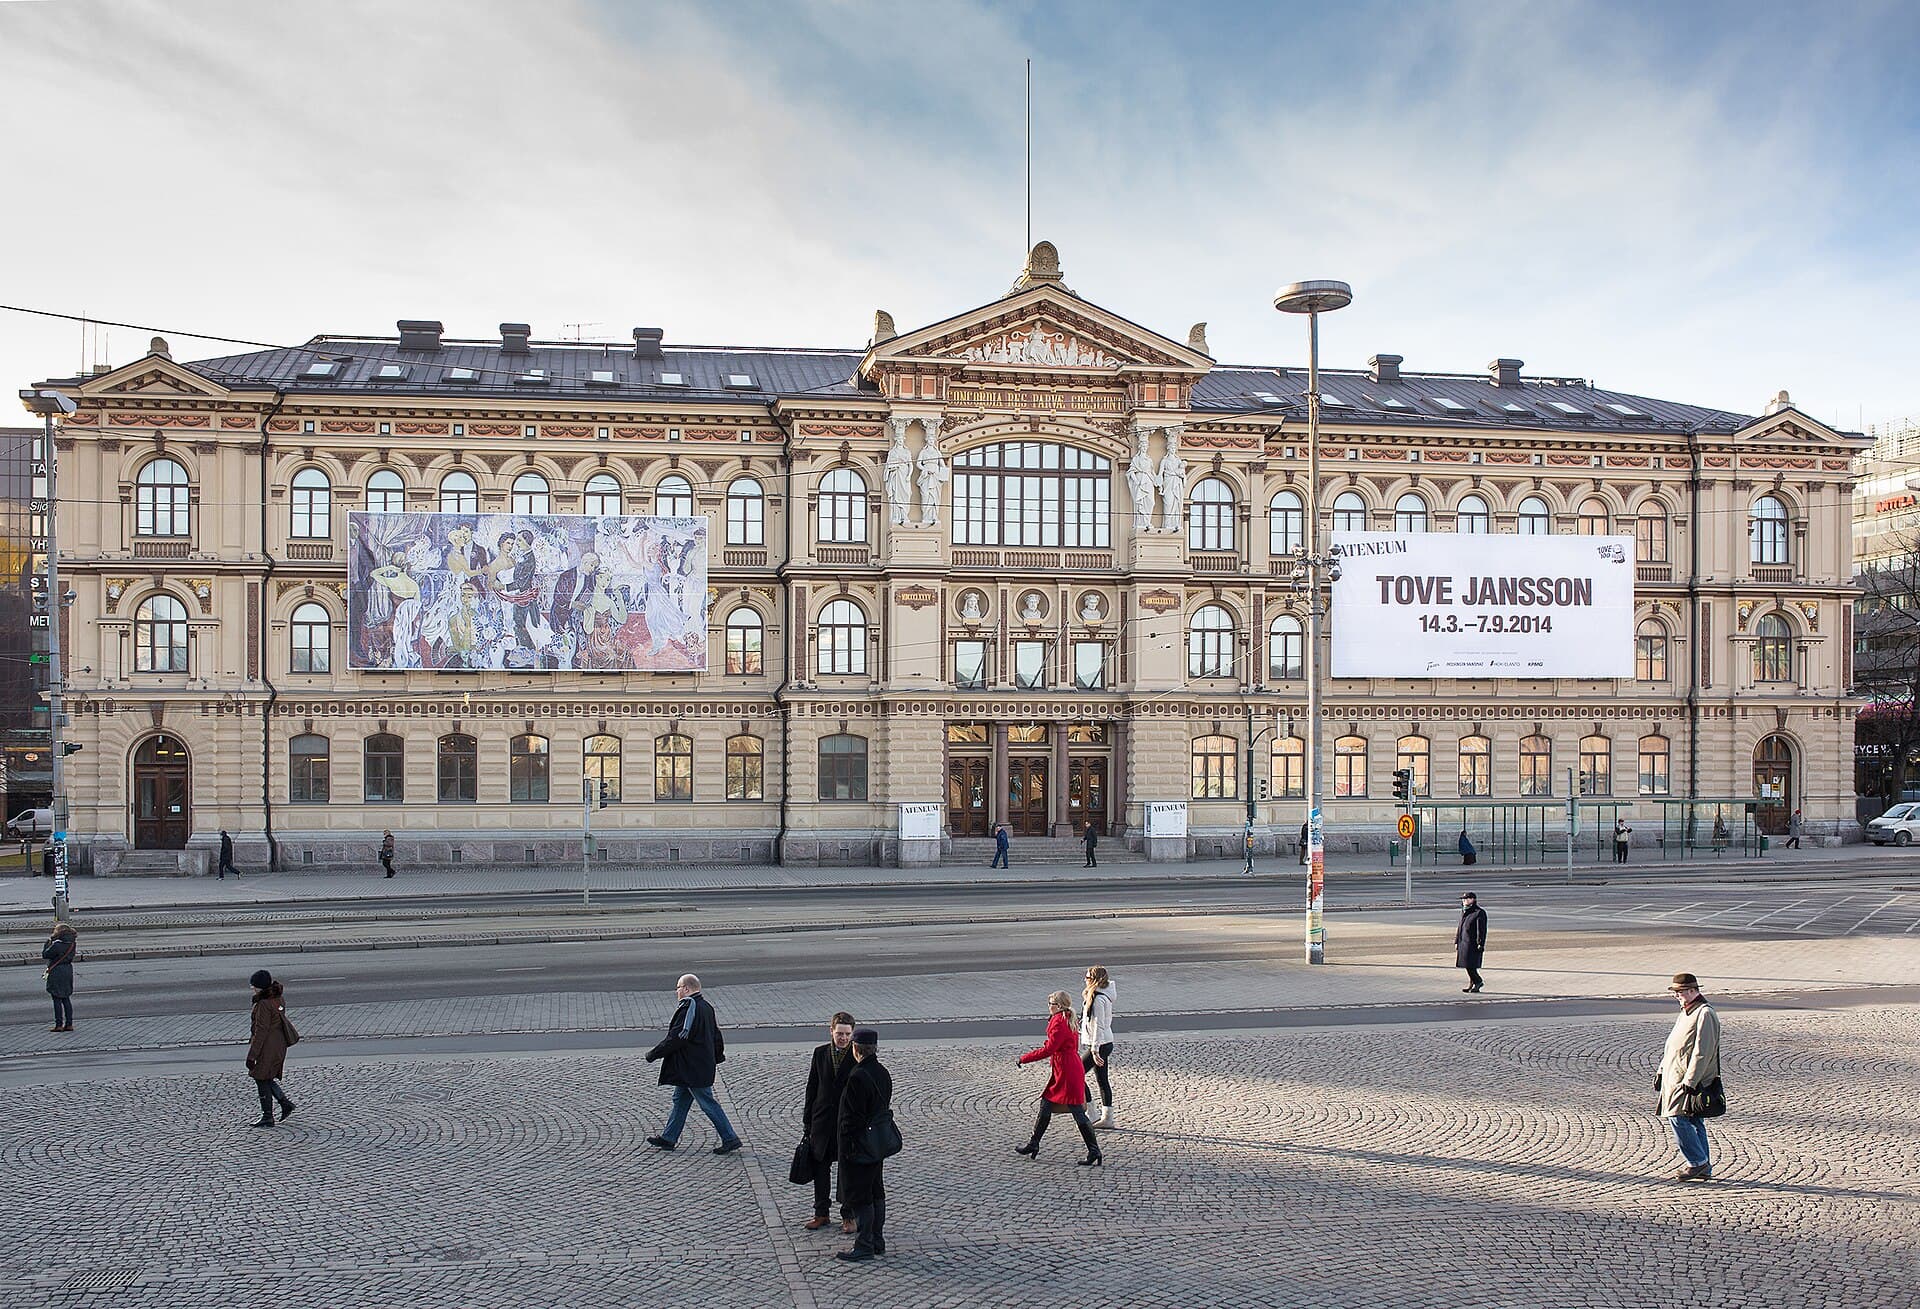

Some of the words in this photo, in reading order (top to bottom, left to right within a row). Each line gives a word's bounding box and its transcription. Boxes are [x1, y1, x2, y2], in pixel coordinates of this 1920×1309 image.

[948, 391, 1003, 406] CONCORDIA
[1340, 540, 1407, 557] ATENEUM
[1376, 575, 1453, 605] TOVE
[1462, 576, 1592, 606] JANSSON
[1419, 614, 1552, 633] 14.3.–7.9.2014
[904, 804, 939, 814] ATENEUM
[1152, 803, 1186, 813] ATENEUM
